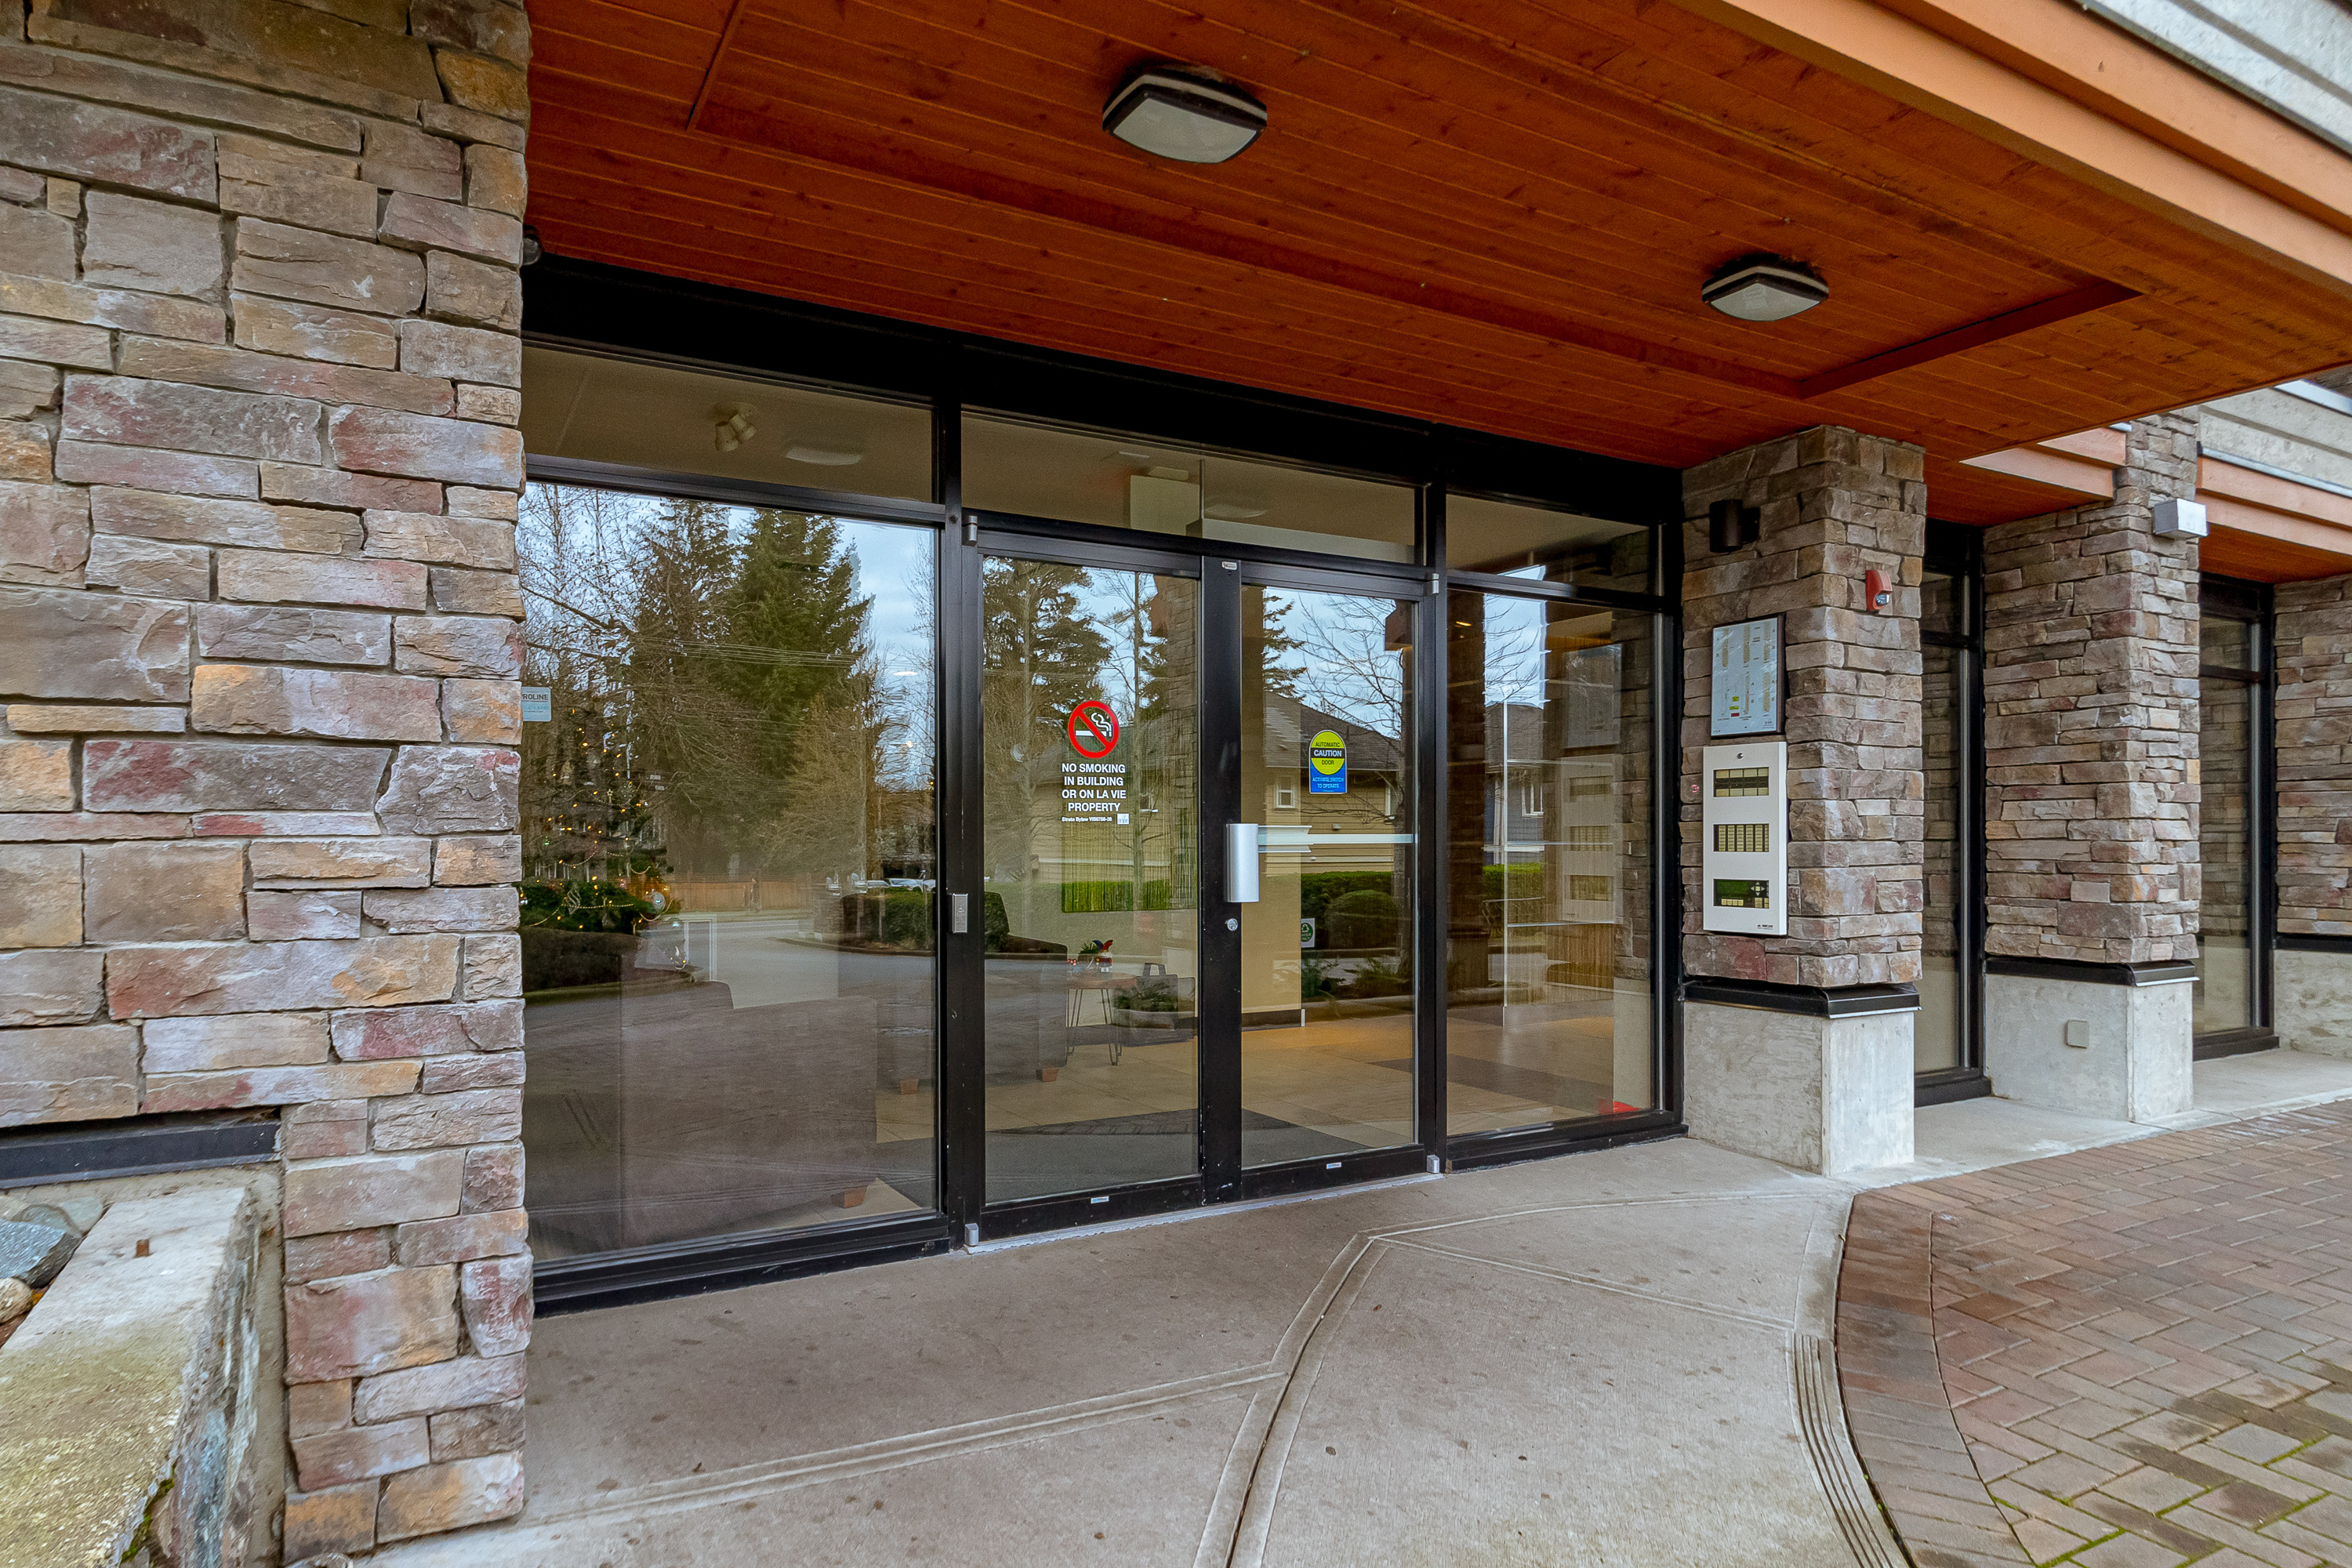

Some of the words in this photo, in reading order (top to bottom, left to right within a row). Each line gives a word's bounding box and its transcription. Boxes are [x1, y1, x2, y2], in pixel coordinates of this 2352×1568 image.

[1062, 763, 1077, 773] NO
[1079, 764, 1126, 774] SMOKING
[1064, 776, 1075, 786] IN
[1076, 776, 1124, 786] BUILDING
[1062, 789, 1077, 799] OR
[1079, 789, 1094, 799] ON
[1096, 789, 1109, 799] LA
[1110, 789, 1127, 799] VIE
[1068, 802, 1121, 812] PROPERTY
